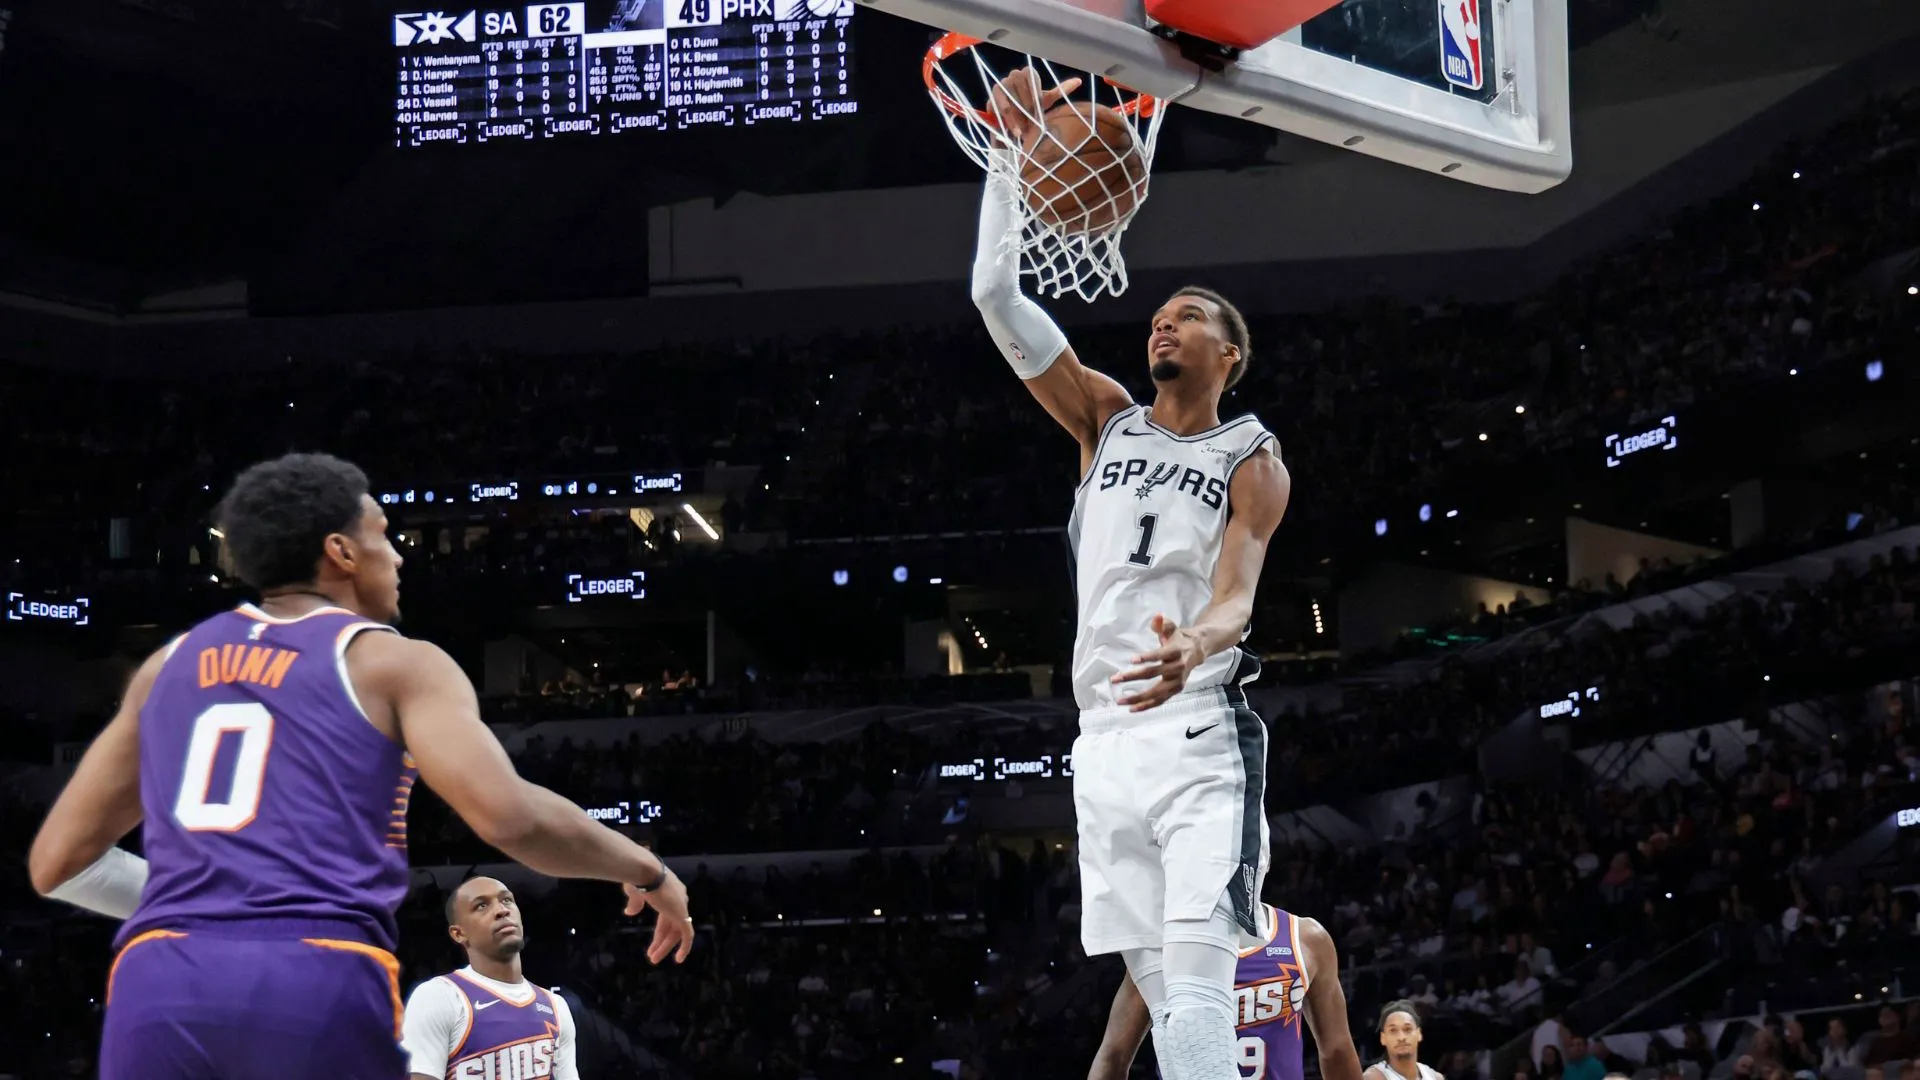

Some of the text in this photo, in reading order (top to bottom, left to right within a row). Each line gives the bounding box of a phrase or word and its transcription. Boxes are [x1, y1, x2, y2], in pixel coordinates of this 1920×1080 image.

[679, 0, 710, 23] 49
[724, 0, 772, 18] PHX
[484, 12, 517, 35] SA
[539, 7, 570, 33] 62
[778, 21, 800, 32] REB
[805, 20, 827, 30] AST
[835, 18, 849, 28] PF
[507, 40, 529, 50] REB
[534, 38, 556, 48] AST
[563, 37, 577, 47] PF
[671, 39, 678, 49] 0
[693, 37, 718, 48] Dunn
[812, 29, 819, 40] 0
[839, 28, 844, 38] 1
[401, 57, 406, 67] 1
[413, 57, 421, 67] V.
[424, 55, 480, 66] Wembanyama
[488, 51, 498, 61] 12
[669, 53, 680, 64] 14
[683, 52, 692, 63] K.
[760, 47, 768, 58] 0
[786, 45, 794, 56] 0
[812, 43, 820, 54] 0
[838, 42, 846, 53] 0
[413, 71, 422, 81] D.
[423, 70, 459, 81] Harper
[542, 62, 549, 72] 0
[569, 60, 574, 71] 1
[670, 67, 680, 78] 17
[683, 67, 692, 77] J.
[694, 66, 729, 77] Bouyea
[840, 56, 845, 67] 1
[1447, 54, 1468, 79] NBA
[423, 83, 453, 94] Castle
[516, 78, 522, 88] 4
[568, 74, 575, 85] 0
[694, 77, 743, 91] Highsmith
[761, 75, 768, 85] 0
[814, 71, 819, 82] 1
[839, 69, 846, 80] 0
[397, 99, 411, 109] 24
[413, 98, 422, 108] D.
[423, 96, 457, 107] Vassell
[542, 90, 550, 100] 0
[684, 94, 693, 105] D.
[695, 92, 723, 104] Reath
[789, 87, 793, 98] 1
[813, 85, 821, 96] 0
[397, 113, 411, 123] 40
[423, 112, 458, 122] Barnes
[518, 105, 522, 116] 1
[543, 104, 550, 114] 0
[569, 102, 576, 112] 0
[419, 128, 459, 141] LEDGER
[486, 124, 525, 136] LEDGER
[552, 120, 592, 132] LEDGER
[619, 115, 659, 128] LEDGER
[686, 110, 726, 123] LEDGER
[753, 106, 793, 119] LEDGER
[1616, 427, 1666, 457] LEDGER
[478, 486, 512, 498] LEDGER
[641, 477, 675, 489] LEDGER
[1100, 459, 1225, 510] SPURS
[1125, 512, 1159, 568] 1
[580, 578, 634, 594] LEDGER
[21, 601, 78, 618] LEDGER
[198, 643, 299, 689] DUNN
[1540, 699, 1573, 718] EDGER
[174, 702, 275, 833] 0
[940, 761, 1044, 777] EDGER LEDGER
[587, 807, 622, 820] EDGER
